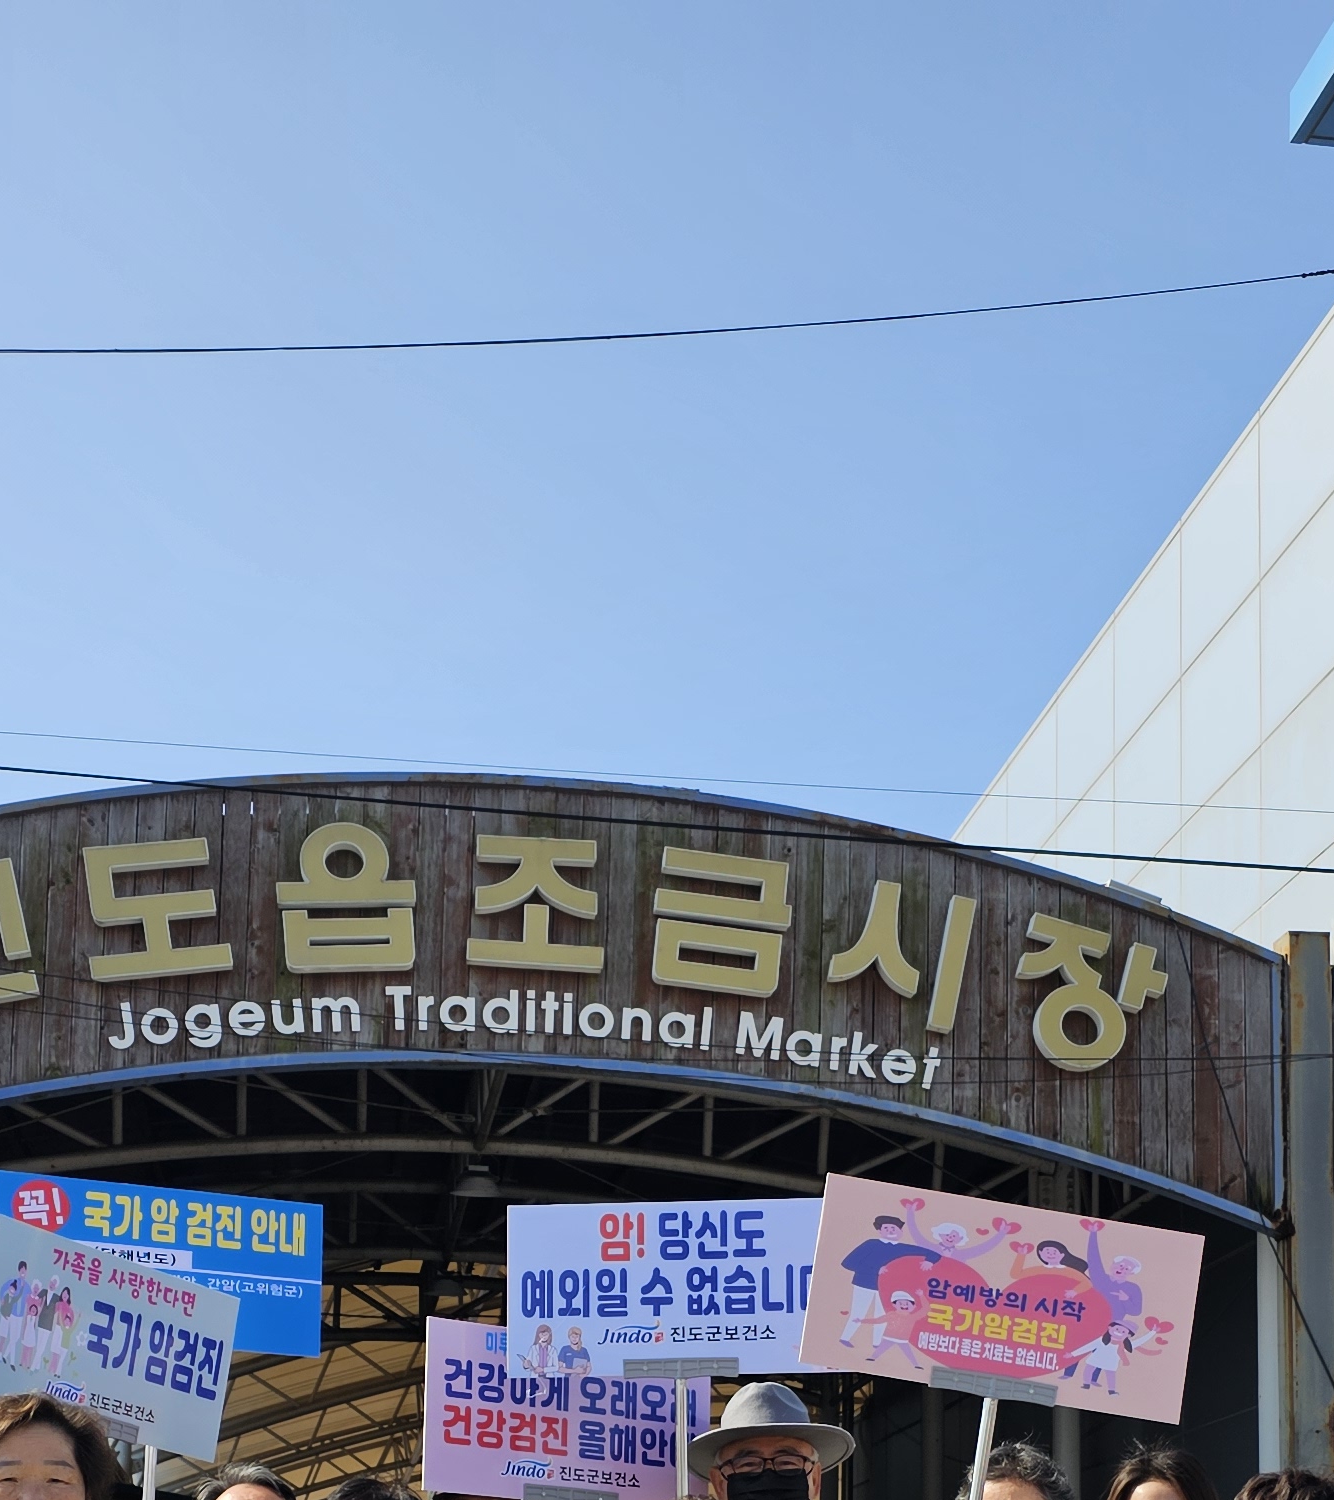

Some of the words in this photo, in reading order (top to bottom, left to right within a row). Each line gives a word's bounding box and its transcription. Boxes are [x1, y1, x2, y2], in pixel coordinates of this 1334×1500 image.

[108, 994, 362, 1053] Jogeum
[385, 985, 714, 1049] Traditional
[734, 1012, 942, 1090] Market
[17, 1187, 64, 1225] 꼭!
[83, 1190, 141, 1240] 국가
[150, 1198, 179, 1244] 암
[186, 1203, 242, 1250] 검진
[250, 1210, 305, 1257] 안내
[600, 1213, 645, 1261] 암!
[658, 1210, 766, 1261] 당신도
[52, 1248, 102, 1285] 가족을
[107, 1266, 196, 1317] 사랑한다면
[521, 1268, 628, 1319] 예외일
[640, 1267, 673, 1316] 수
[927, 1278, 1027, 1312] 암예방의
[1034, 1298, 1086, 1322] 시작
[597, 1325, 655, 1345] Jindo
[670, 1325, 776, 1342] 진도군보건소
[927, 1303, 1066, 1349] 국가암검진
[86, 1300, 141, 1377] 국가
[144, 1321, 224, 1401] 암검진
[918, 1331, 959, 1354] 예방보다
[961, 1338, 981, 1358] 좋은
[982, 1342, 1014, 1363] 치료는
[1015, 1347, 1059, 1370] 없습니다.
[89, 1393, 154, 1423] 진도군보건소
[442, 1404, 568, 1456] 건강검진
[501, 1458, 547, 1479] Jindo
[559, 1466, 640, 1488] 진도군보건소
